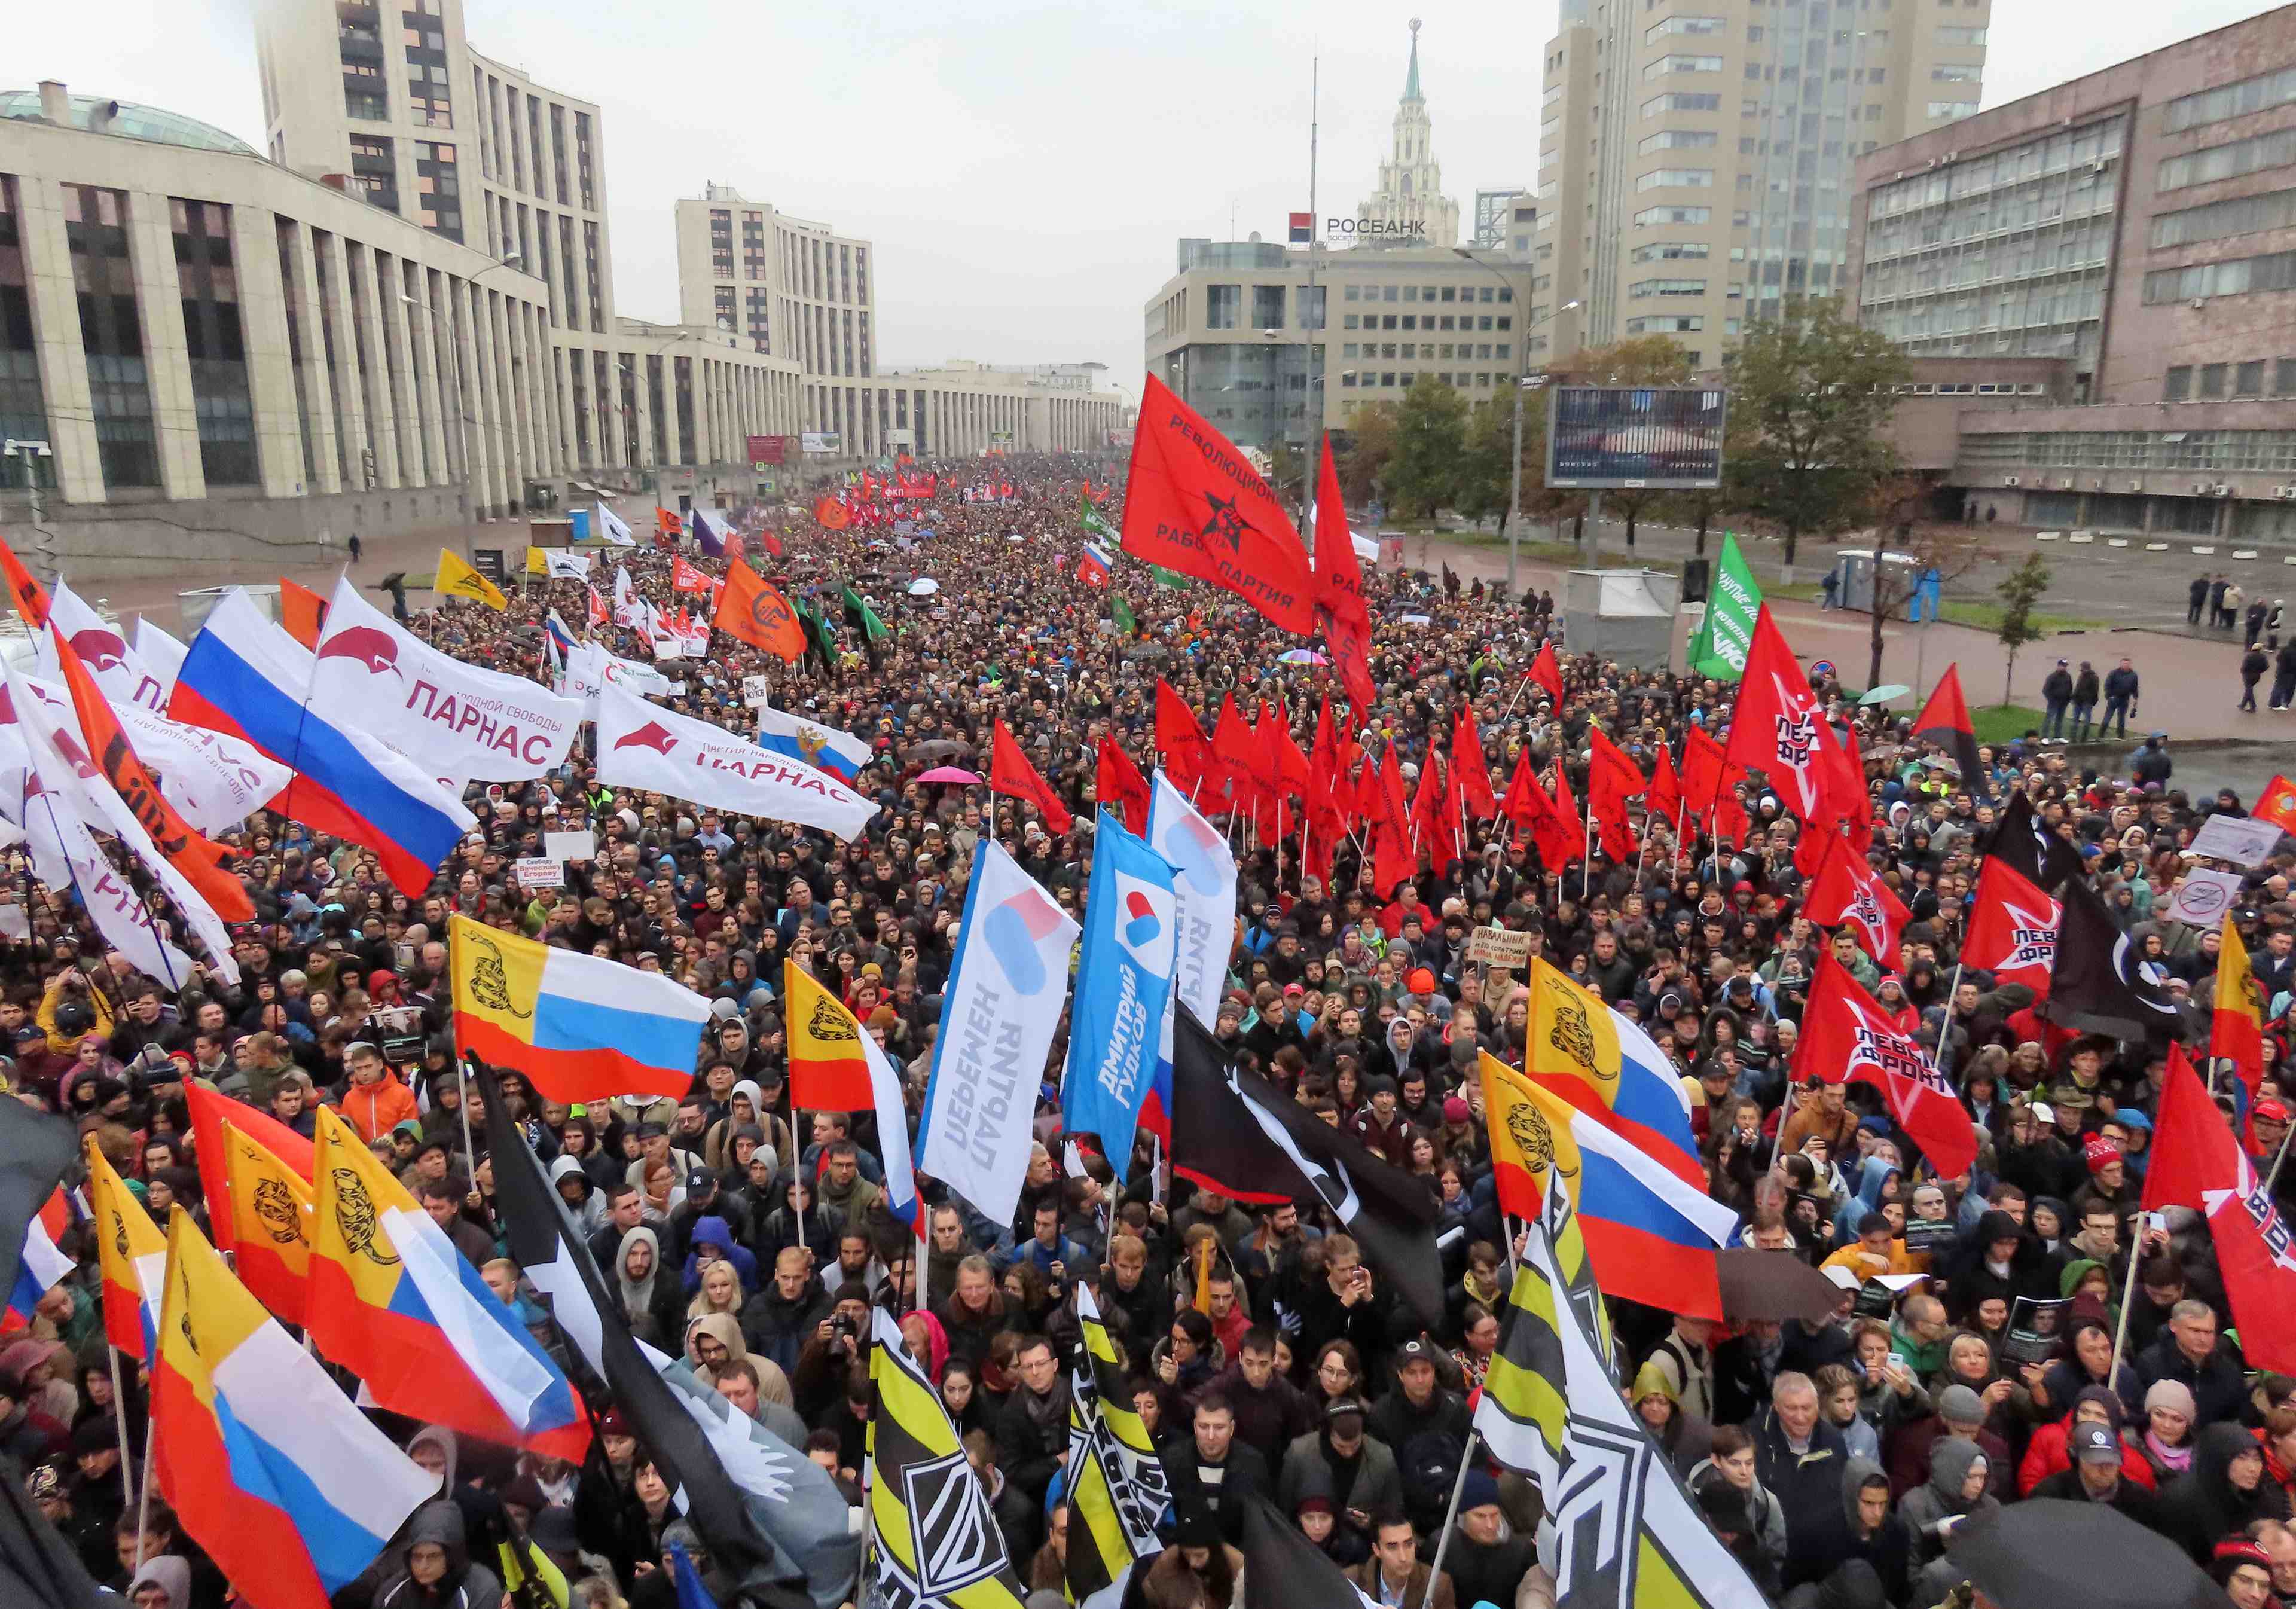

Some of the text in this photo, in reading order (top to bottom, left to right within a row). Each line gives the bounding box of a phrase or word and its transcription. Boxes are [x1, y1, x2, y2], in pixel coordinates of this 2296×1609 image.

[1327, 218, 1426, 234] РОСБАНК
[1219, 560, 1294, 609] ПАРТИЯ
[405, 679, 552, 765] ПАРНАС
[506, 706, 563, 732] СВОБОДЫ
[703, 742, 746, 755] ПАРТИЯ
[2015, 930, 2057, 944] ЛЕВ
[1098, 963, 1137, 1094] ДМИТРИЙ
[1114, 999, 1147, 1110] ГУДКОВ
